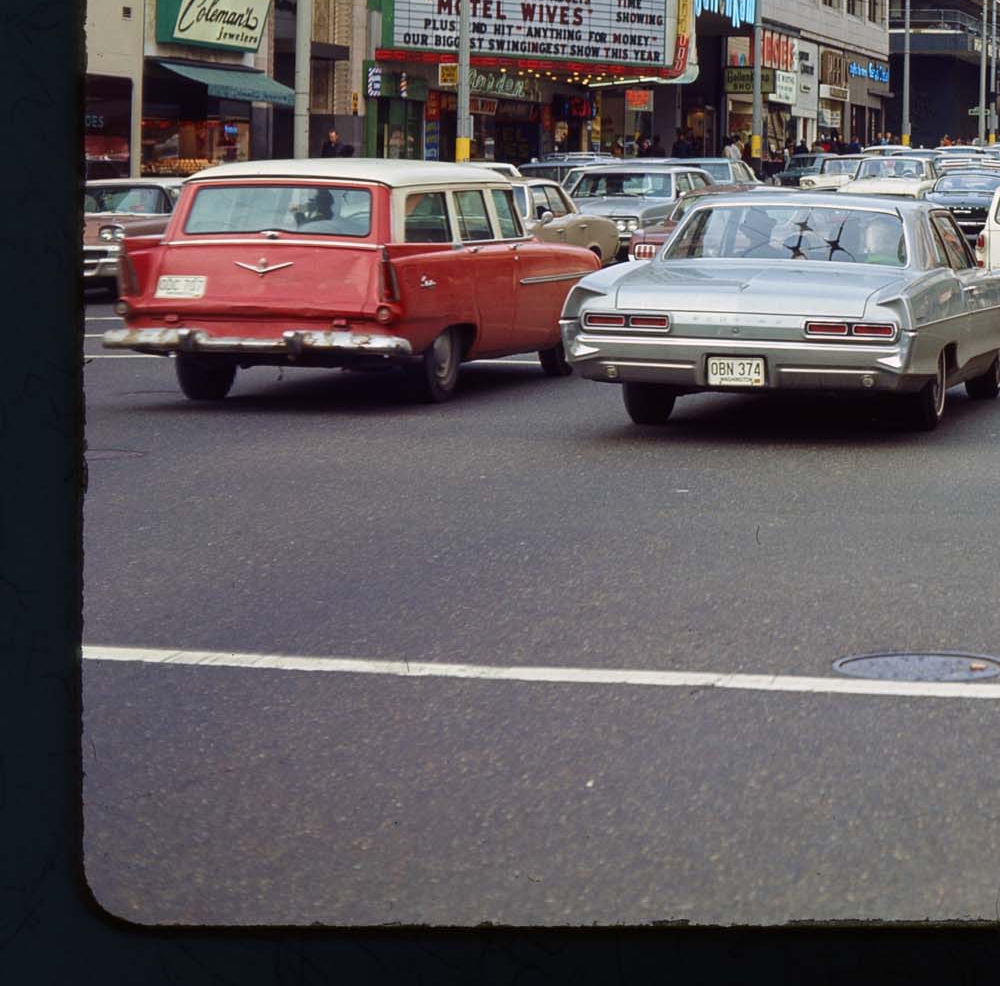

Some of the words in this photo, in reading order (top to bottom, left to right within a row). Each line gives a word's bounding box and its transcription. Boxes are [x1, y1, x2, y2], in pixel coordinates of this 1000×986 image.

[616, 11, 663, 26] SHOWING
[216, 26, 258, 44] jewelers
[423, 18, 456, 32] PLUS
[494, 24, 514, 35] HIT
[588, 31, 608, 43] FOR
[403, 33, 429, 46] OUR
[434, 35, 485, 50] BIGGST
[488, 38, 567, 55] SWINGINGEST
[570, 45, 600, 57] SHOW
[604, 47, 629, 60] THIS
[633, 49, 661, 62] YEAR
[738, 362, 761, 376] 374
